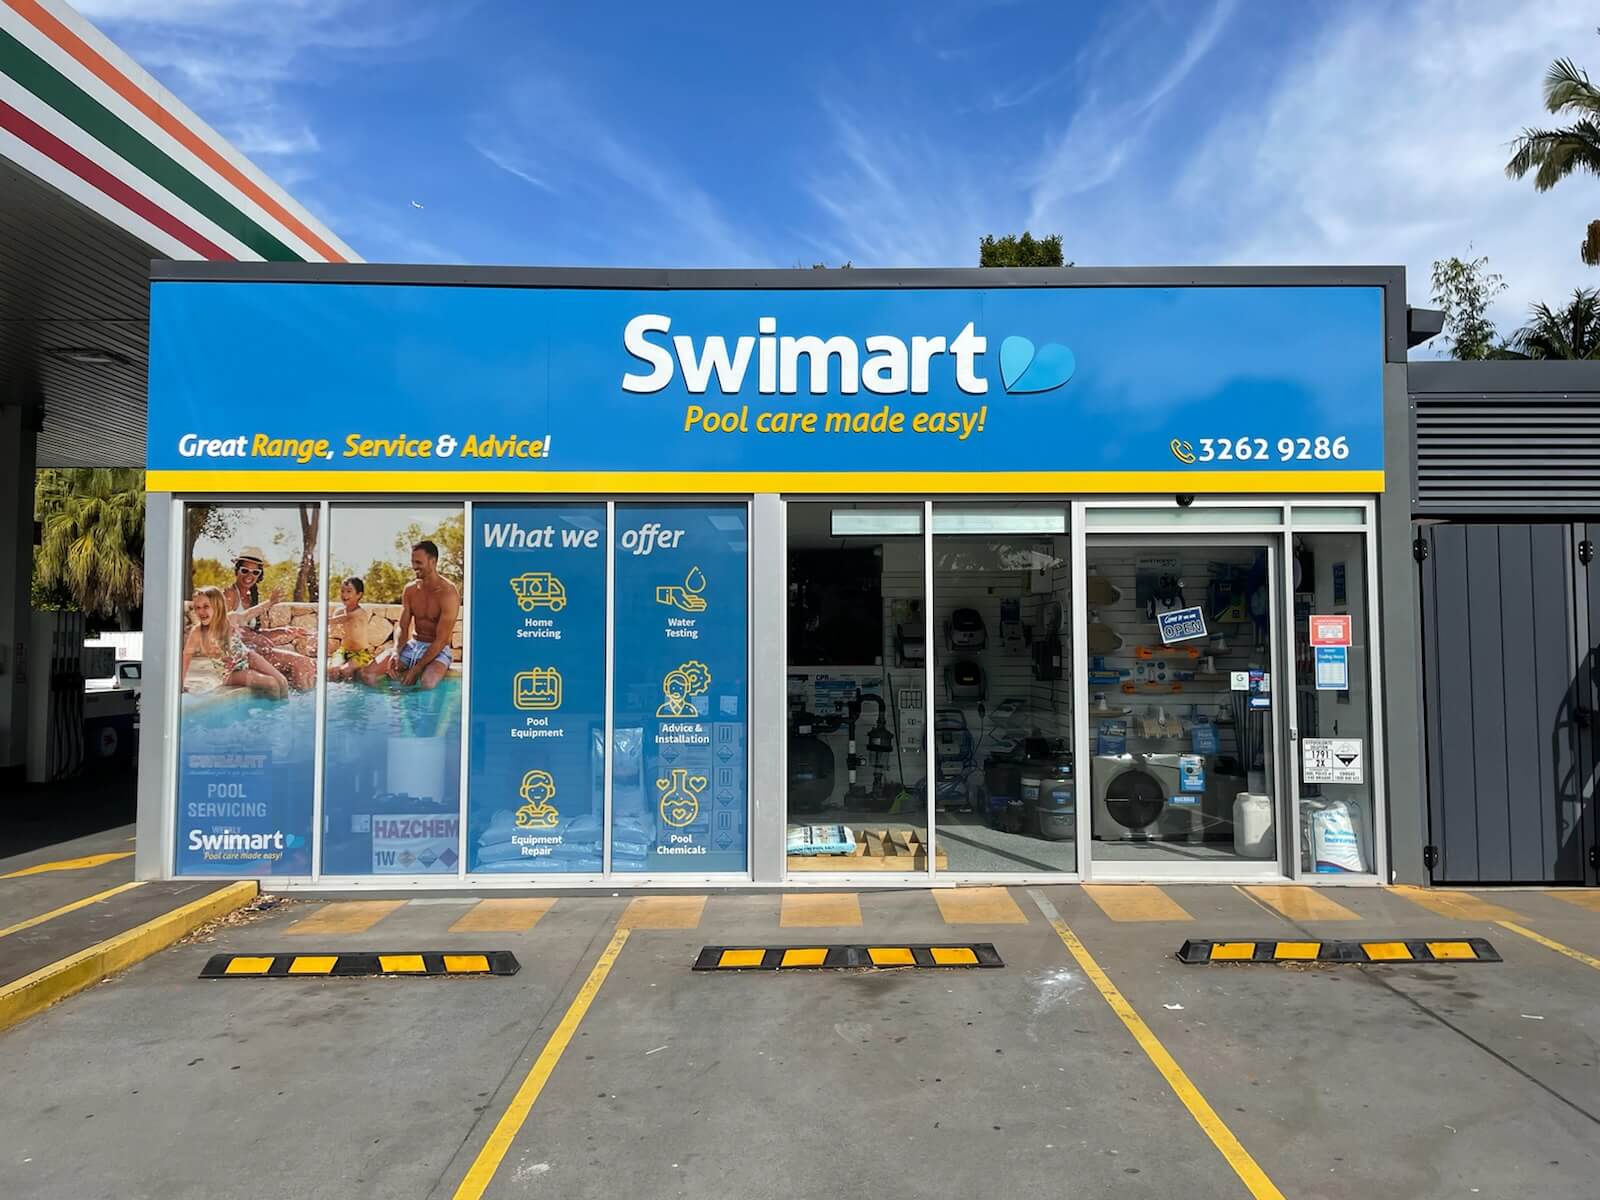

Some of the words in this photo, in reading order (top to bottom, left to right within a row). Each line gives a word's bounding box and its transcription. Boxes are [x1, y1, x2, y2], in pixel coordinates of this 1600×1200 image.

[622, 313, 989, 394] Swimart
[684, 406, 749, 434] Pool
[756, 412, 817, 434] care
[824, 406, 905, 434] made
[911, 406, 988, 440] easy!
[178, 434, 248, 458] Great
[250, 434, 334, 464] Range,
[342, 434, 432, 458] Service
[435, 435, 457, 458] &
[460, 434, 551, 458] Advice!
[1199, 437, 1270, 461] 3262
[1277, 437, 1350, 461] 9286
[483, 523, 555, 548] What
[562, 529, 599, 548] we
[621, 523, 685, 555] offer
[525, 618, 553, 627] Home
[668, 618, 696, 627] Water
[1164, 619, 1202, 638] OPEN
[516, 629, 561, 640] Servicing
[665, 629, 698, 640] Testing
[526, 717, 549, 726] Pool
[511, 728, 564, 738] Equipment
[662, 724, 693, 733] Advice
[695, 724, 703, 733] &
[655, 735, 710, 744] Installation
[1311, 750, 1329, 759] 1791
[1316, 759, 1326, 767] 2X
[207, 783, 247, 798] POOL
[187, 802, 267, 818] SERVICING
[374, 820, 459, 839] HAZCHEM
[188, 829, 284, 850] Swimart
[511, 835, 563, 846] Equipment
[670, 834, 693, 844] Pool
[521, 846, 553, 857] Repair
[657, 846, 707, 855] Chemicals
[204, 852, 222, 861] Pool
[240, 852, 262, 861] made
[263, 852, 284, 862] easy!
[375, 851, 396, 866] 1W
